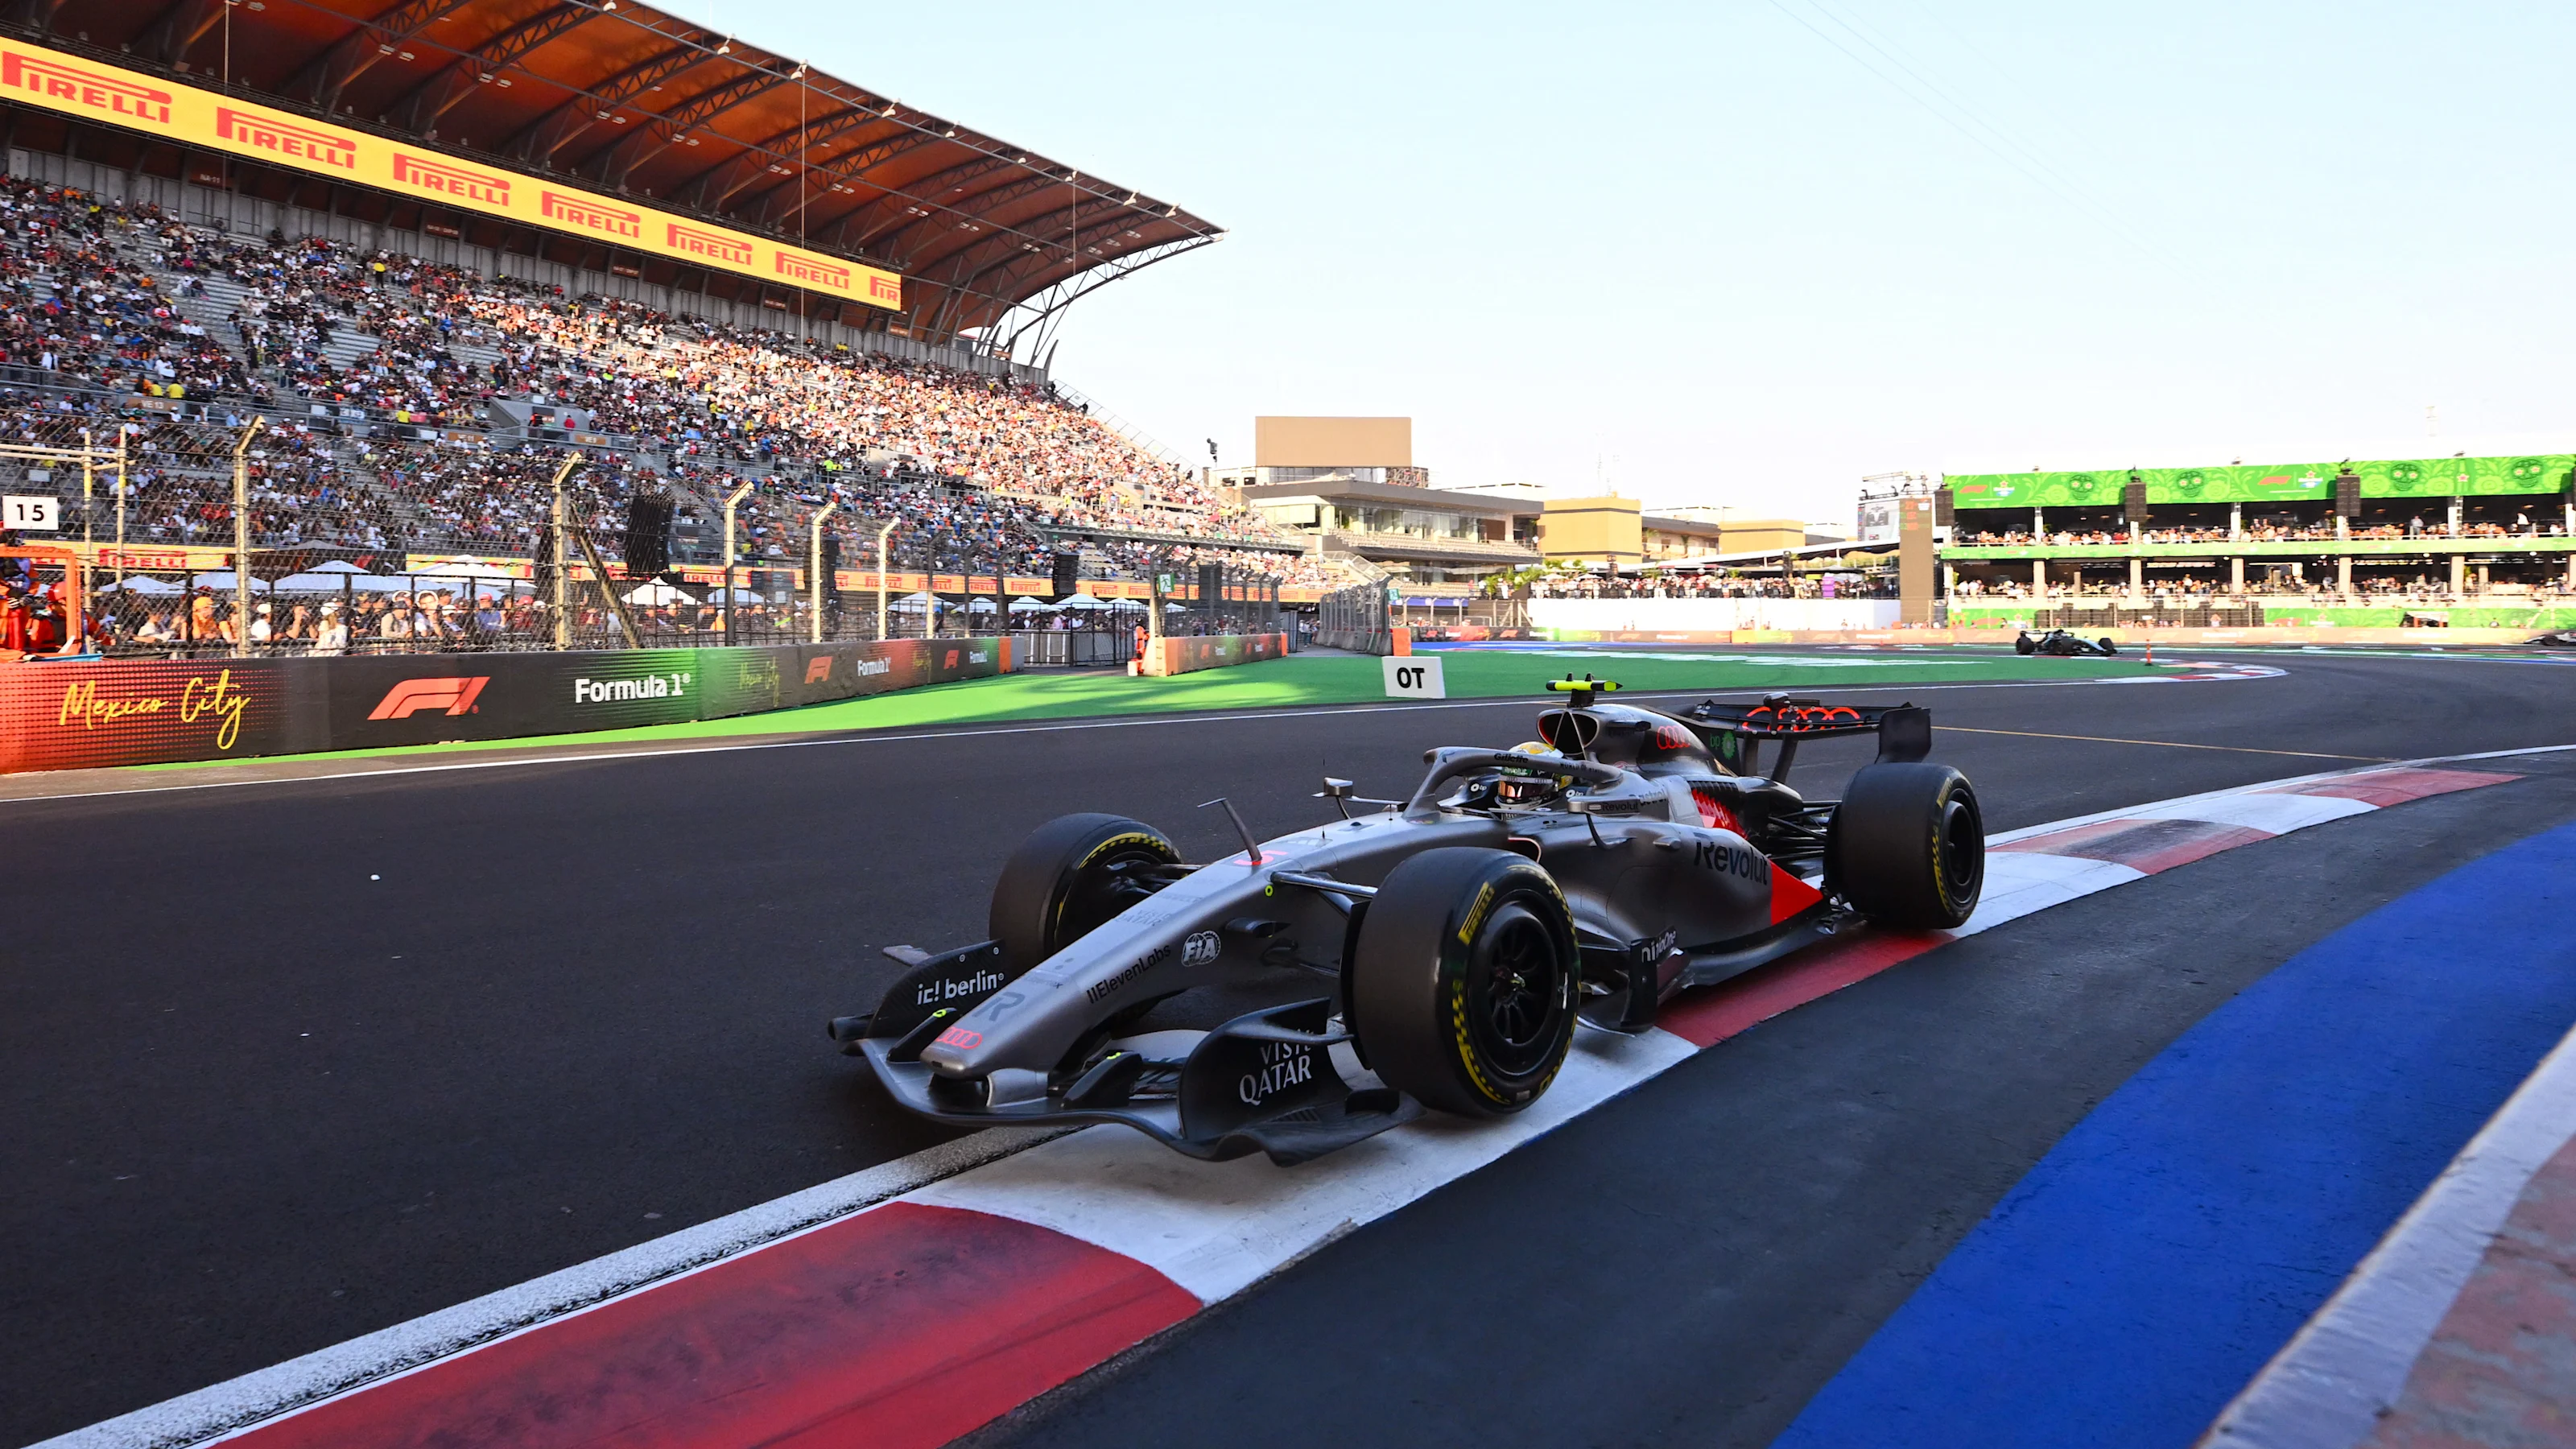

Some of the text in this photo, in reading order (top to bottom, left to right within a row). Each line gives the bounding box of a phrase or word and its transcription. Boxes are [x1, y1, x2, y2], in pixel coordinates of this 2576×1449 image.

[2, 51, 172, 123] PIRELLI
[217, 106, 357, 169] PIRELLI
[394, 152, 511, 207] PIRELLI
[541, 191, 641, 238] PIRELLI
[667, 223, 753, 266] PIRELLI
[775, 250, 850, 290] PIRELLI
[16, 504, 44, 522] 15
[98, 548, 187, 568] PIRELLI
[857, 658, 885, 677] Formula
[1397, 667, 1425, 689] OT
[60, 668, 252, 749] Mexico City
[575, 675, 667, 704] Formula
[1494, 753, 1529, 764] Gillette
[1710, 733, 1720, 749] bp
[1602, 802, 1639, 811] Revolut
[1693, 832, 1768, 886] Revolut
[1239, 1055, 1312, 1106] QATAR
